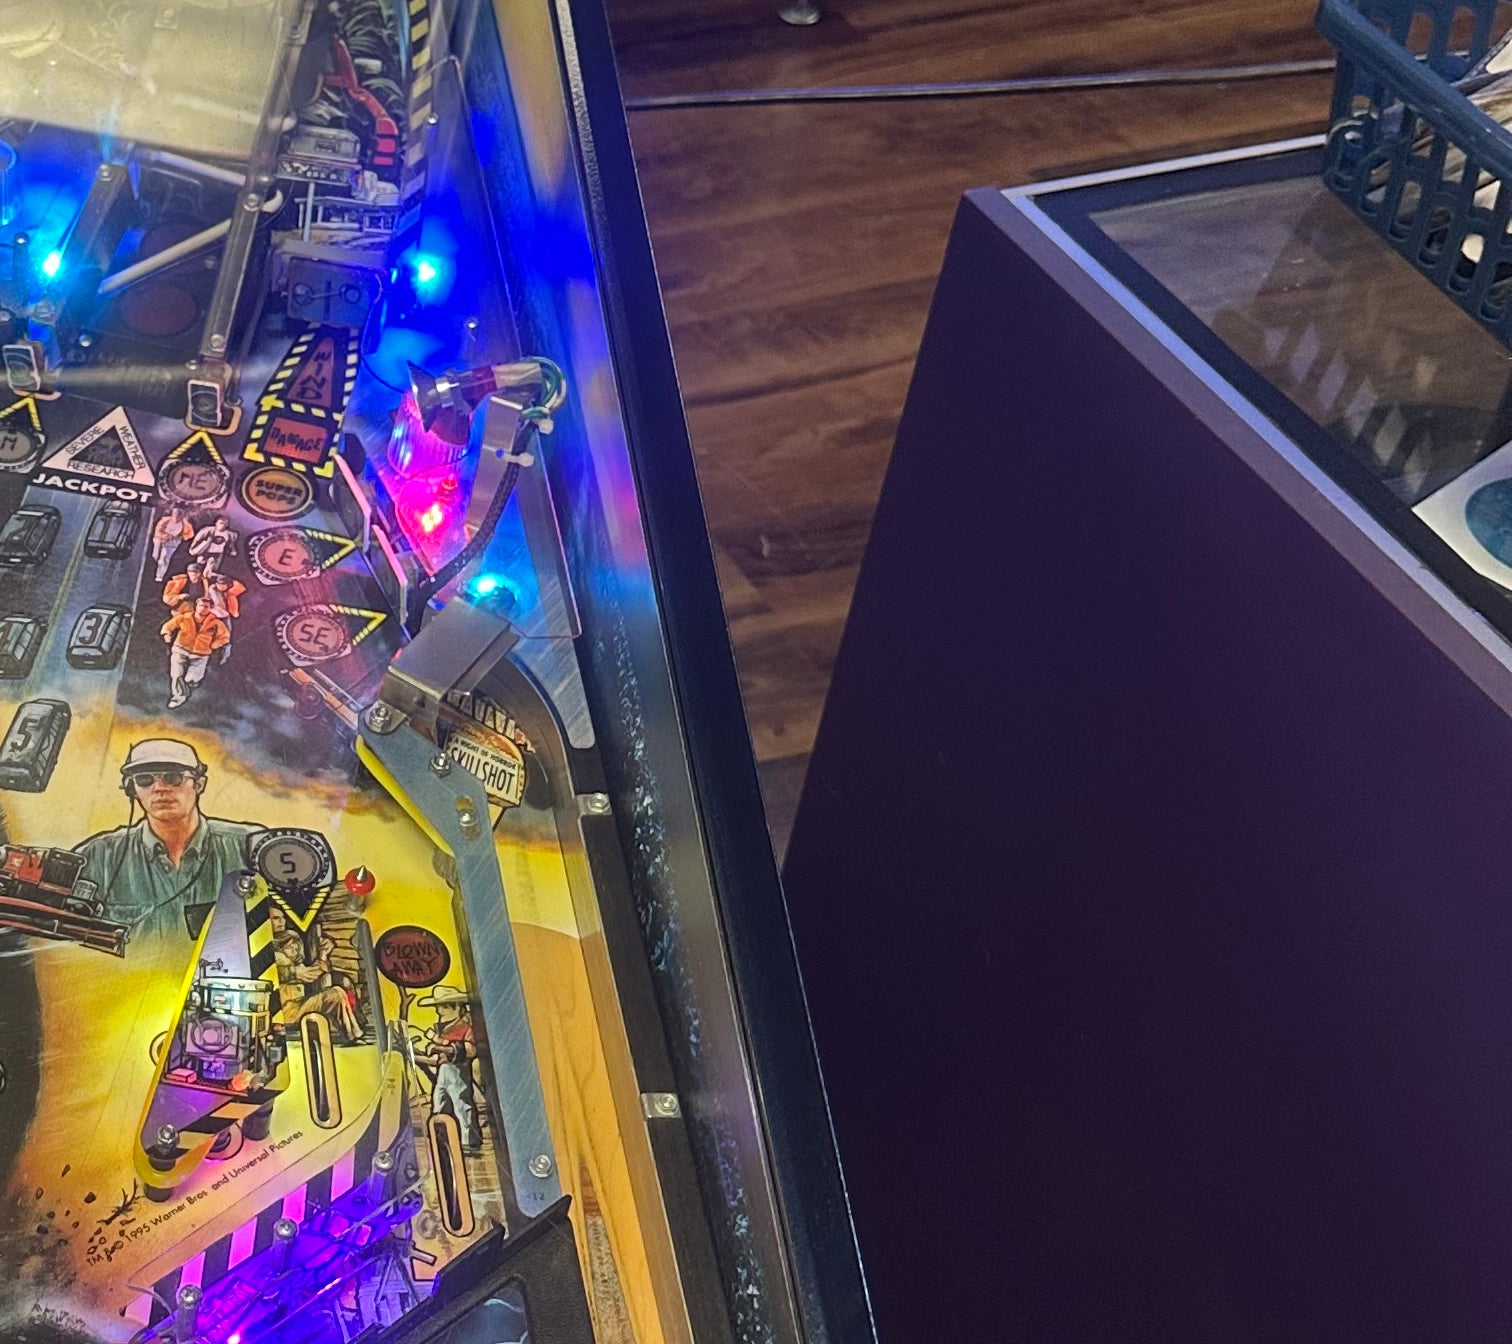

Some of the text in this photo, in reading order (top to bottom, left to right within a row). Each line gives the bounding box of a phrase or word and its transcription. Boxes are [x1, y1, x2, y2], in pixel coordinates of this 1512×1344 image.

[296, 351, 332, 401] WIND
[65, 425, 147, 470] SEVERE WEATHER
[269, 426, 326, 453] DAMAGE
[67, 459, 136, 481] RESEARCH
[32, 473, 154, 504] JACKPOT
[255, 477, 304, 499] SUPER
[255, 487, 297, 506] POPS
[278, 547, 297, 566] E
[78, 614, 102, 645] 3
[298, 623, 331, 646] SE
[10, 716, 38, 752] 5
[450, 746, 516, 795] SKILLSHOT
[279, 852, 296, 874] S
[382, 941, 439, 960] BLOWN
[390, 959, 437, 978] AWAY
[86, 1253, 105, 1266] TM
[125, 1223, 151, 1243] 1995
[150, 1203, 187, 1227] Warner
[211, 1172, 230, 1191] and
[230, 1150, 270, 1179] Universal
[268, 1130, 304, 1152] Pictures
